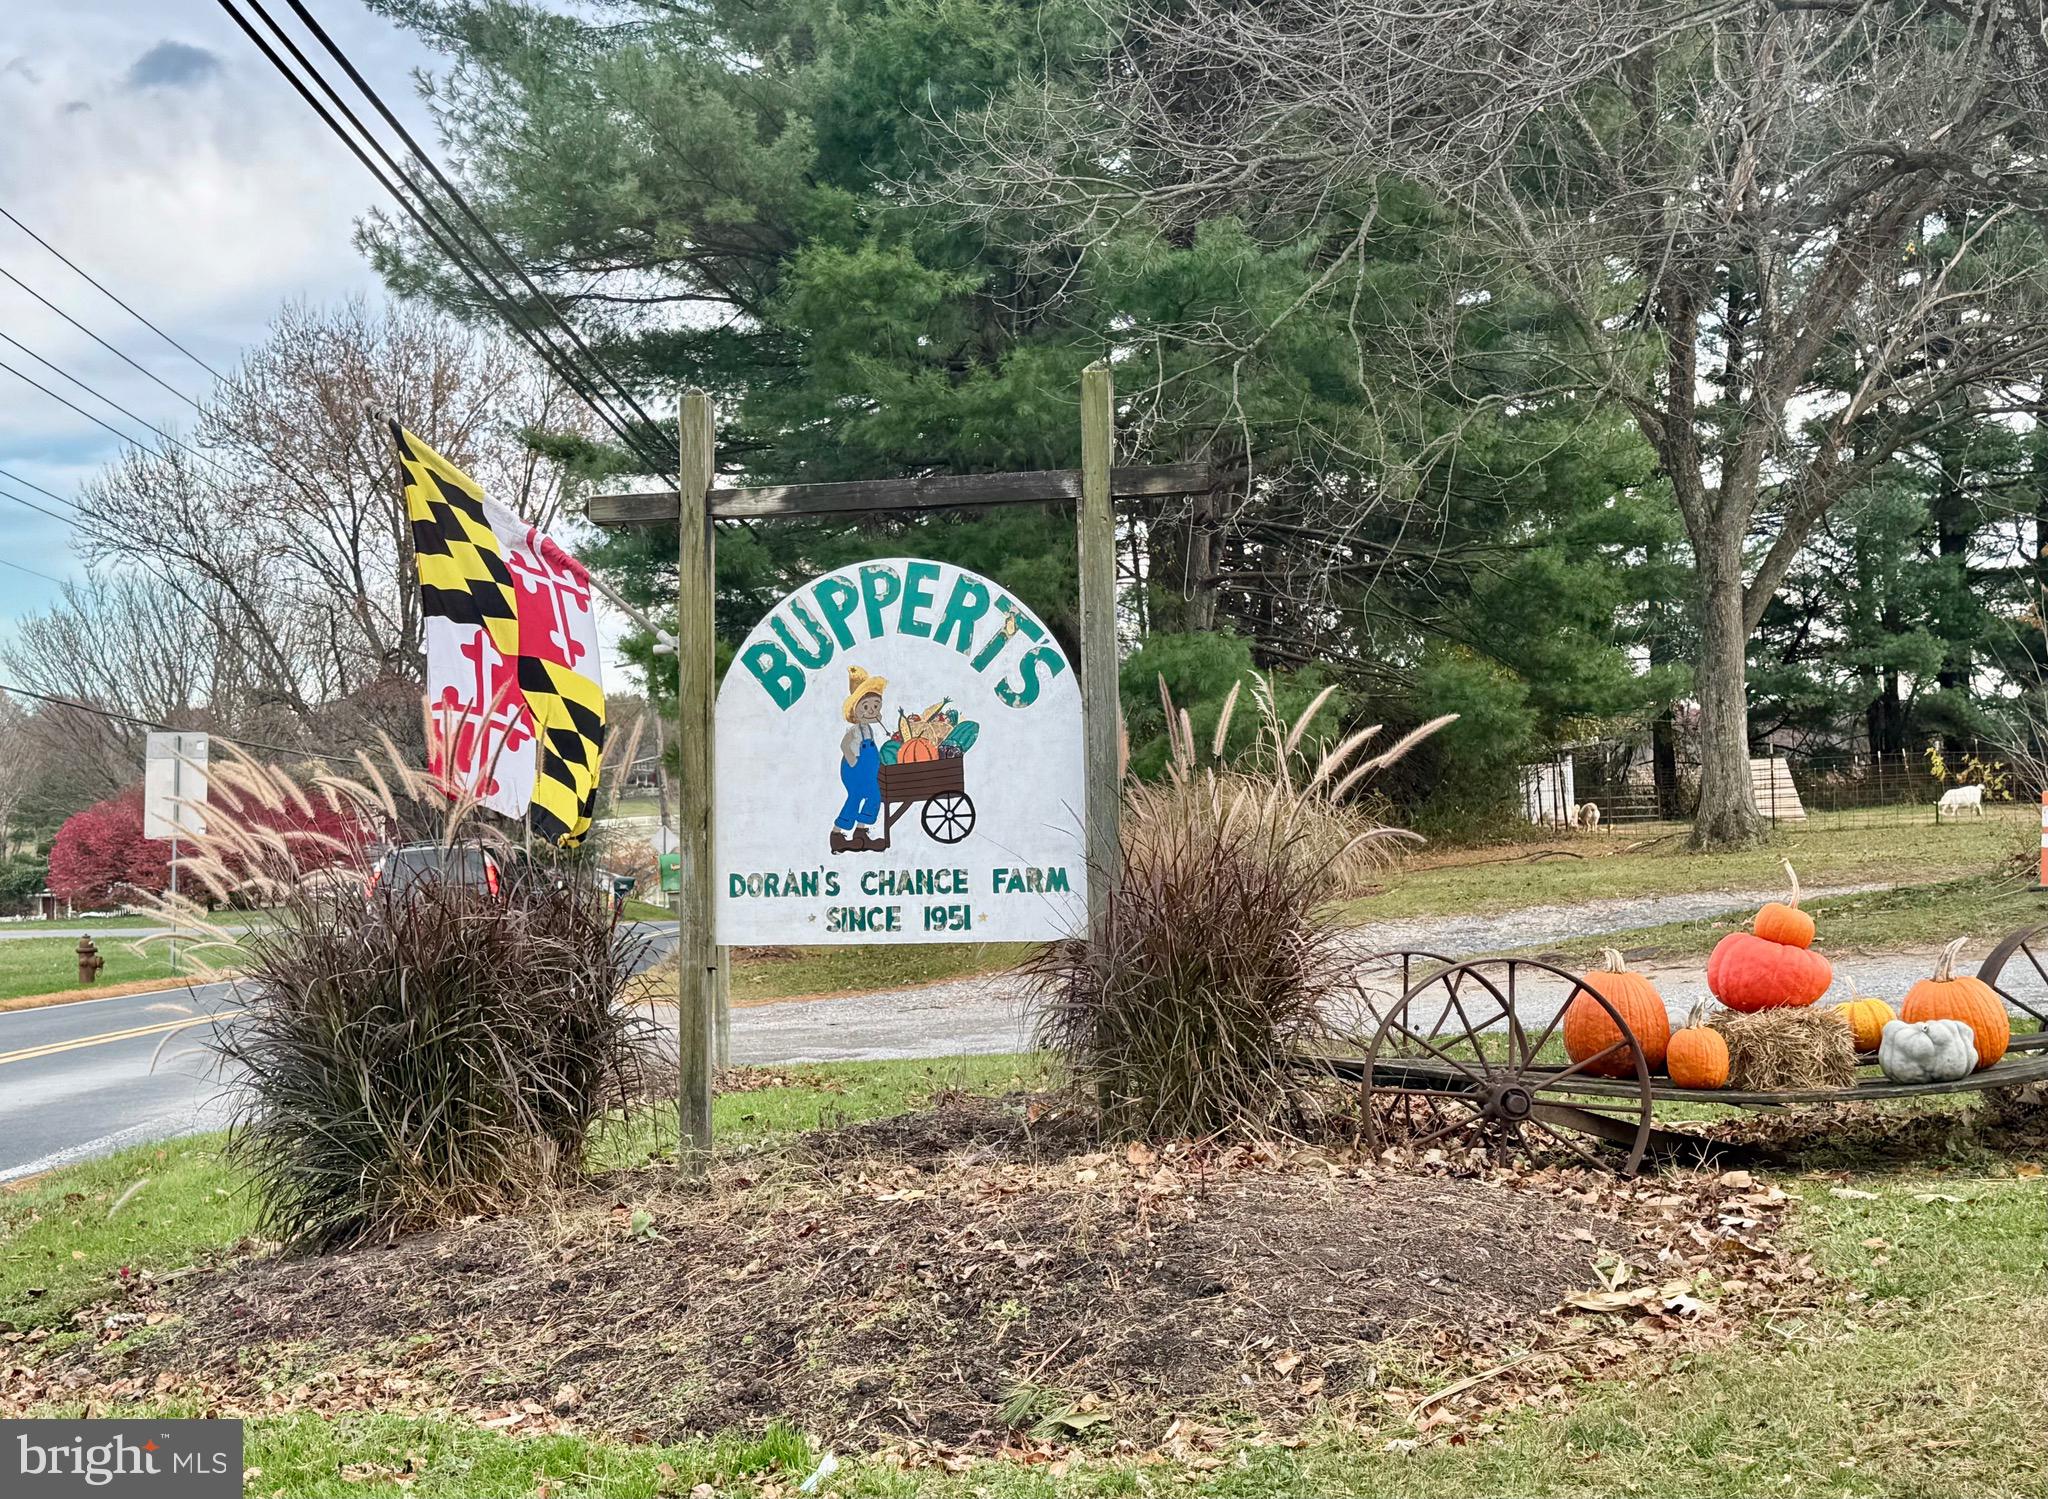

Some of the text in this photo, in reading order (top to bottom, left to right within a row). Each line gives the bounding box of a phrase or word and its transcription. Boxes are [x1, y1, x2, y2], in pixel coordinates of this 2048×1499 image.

[741, 562, 1065, 711] BUPPERT'S
[729, 865, 1070, 898] DORAN'S CHANCE FARM
[825, 904, 972, 933] SINCE 1951
